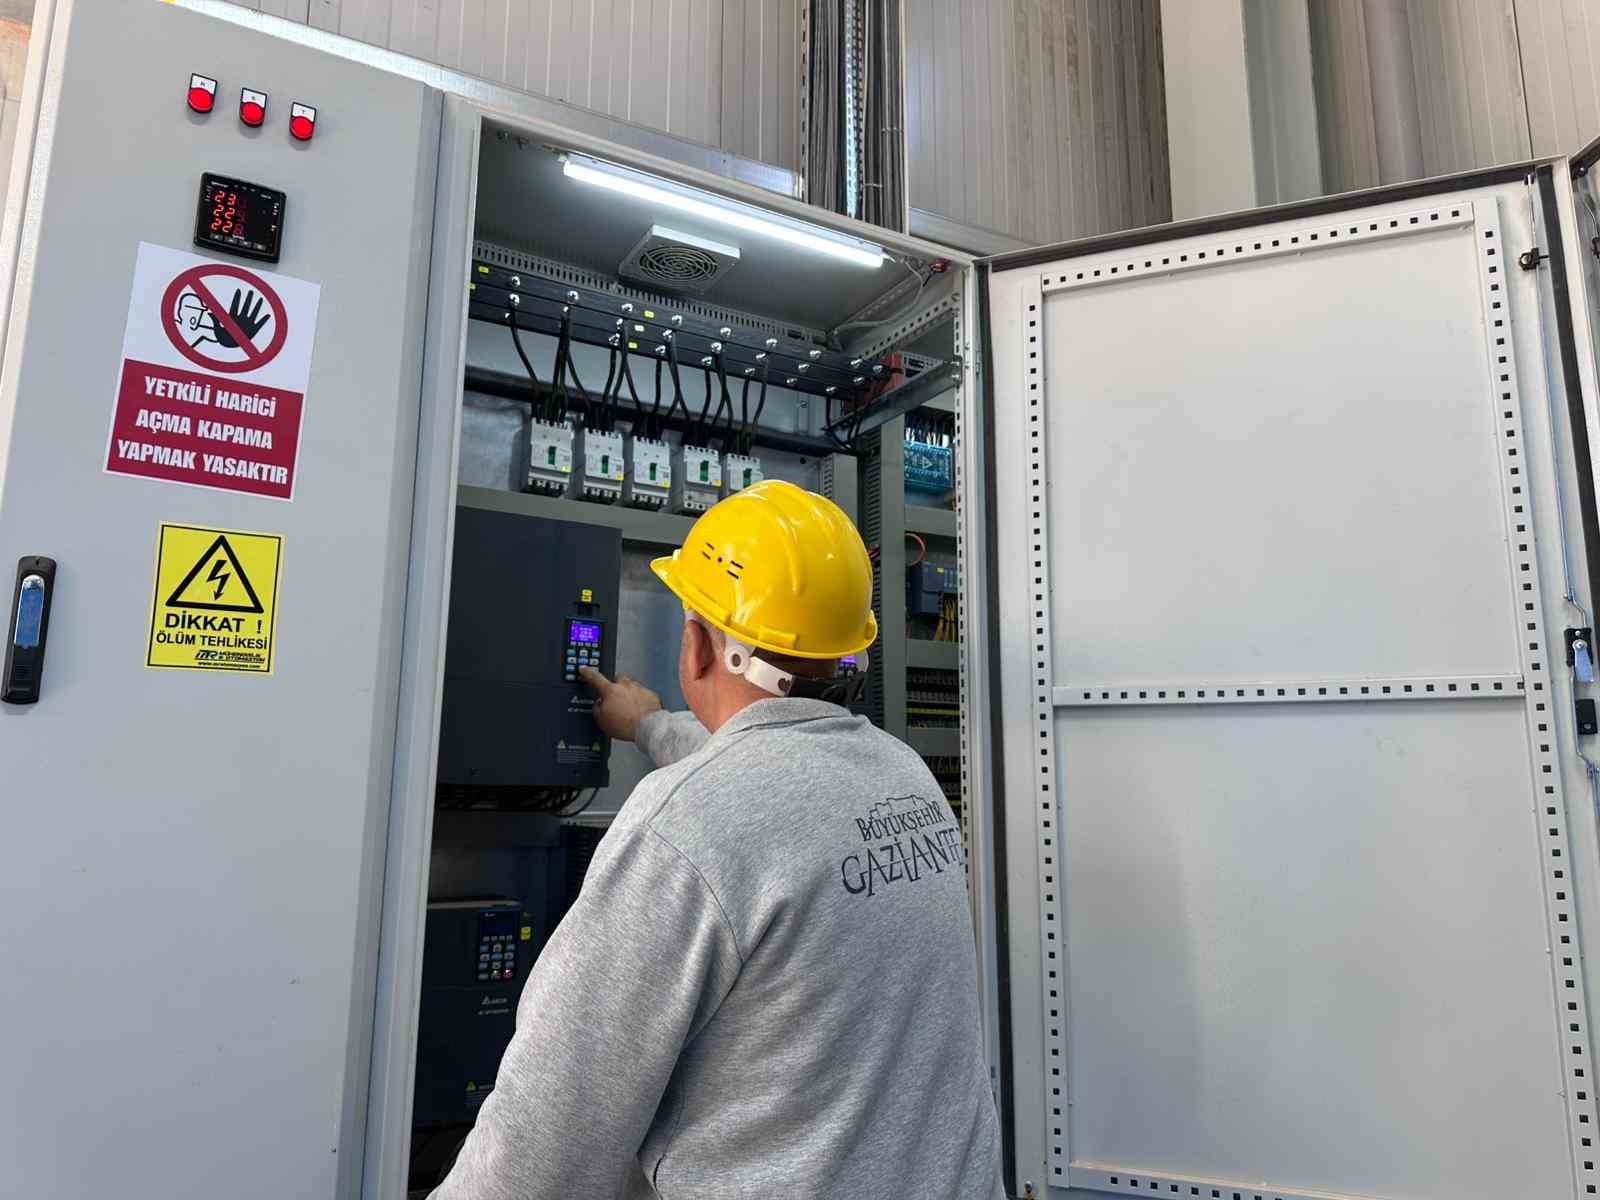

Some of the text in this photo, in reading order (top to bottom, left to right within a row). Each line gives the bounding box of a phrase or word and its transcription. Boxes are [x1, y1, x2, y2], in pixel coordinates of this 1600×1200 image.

[144, 375, 277, 418] YETKİLİ HARİCİ
[135, 408, 273, 450] AÇMA KAPAMA
[116, 439, 289, 485] YAPMAK YASAKTIR
[156, 630, 268, 650] ÖLÜM TEHLİKESİ
[165, 610, 263, 634] DİKKAT !
